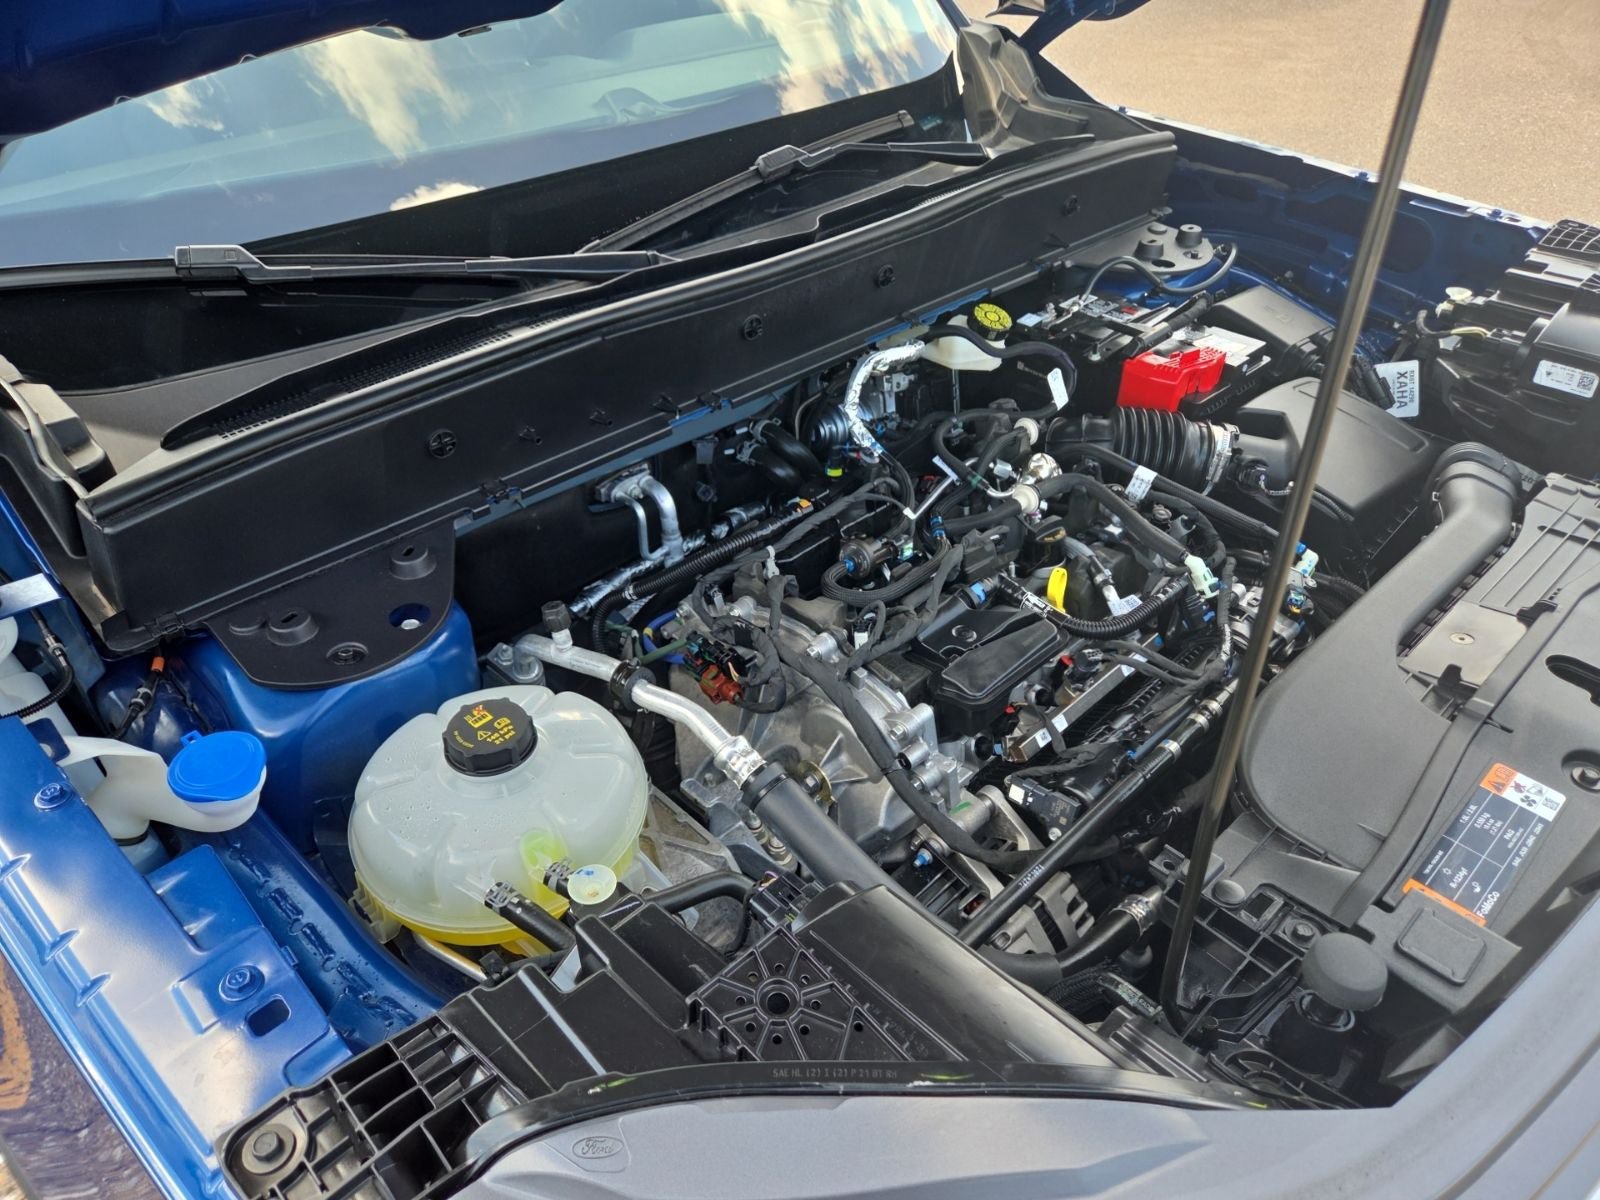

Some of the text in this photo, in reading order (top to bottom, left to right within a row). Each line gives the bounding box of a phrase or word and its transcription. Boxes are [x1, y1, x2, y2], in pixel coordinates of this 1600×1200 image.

[1397, 371, 1408, 409] XAHA
[1476, 891, 1500, 918] FoMoCo
[772, 1068, 790, 1078] SAE
